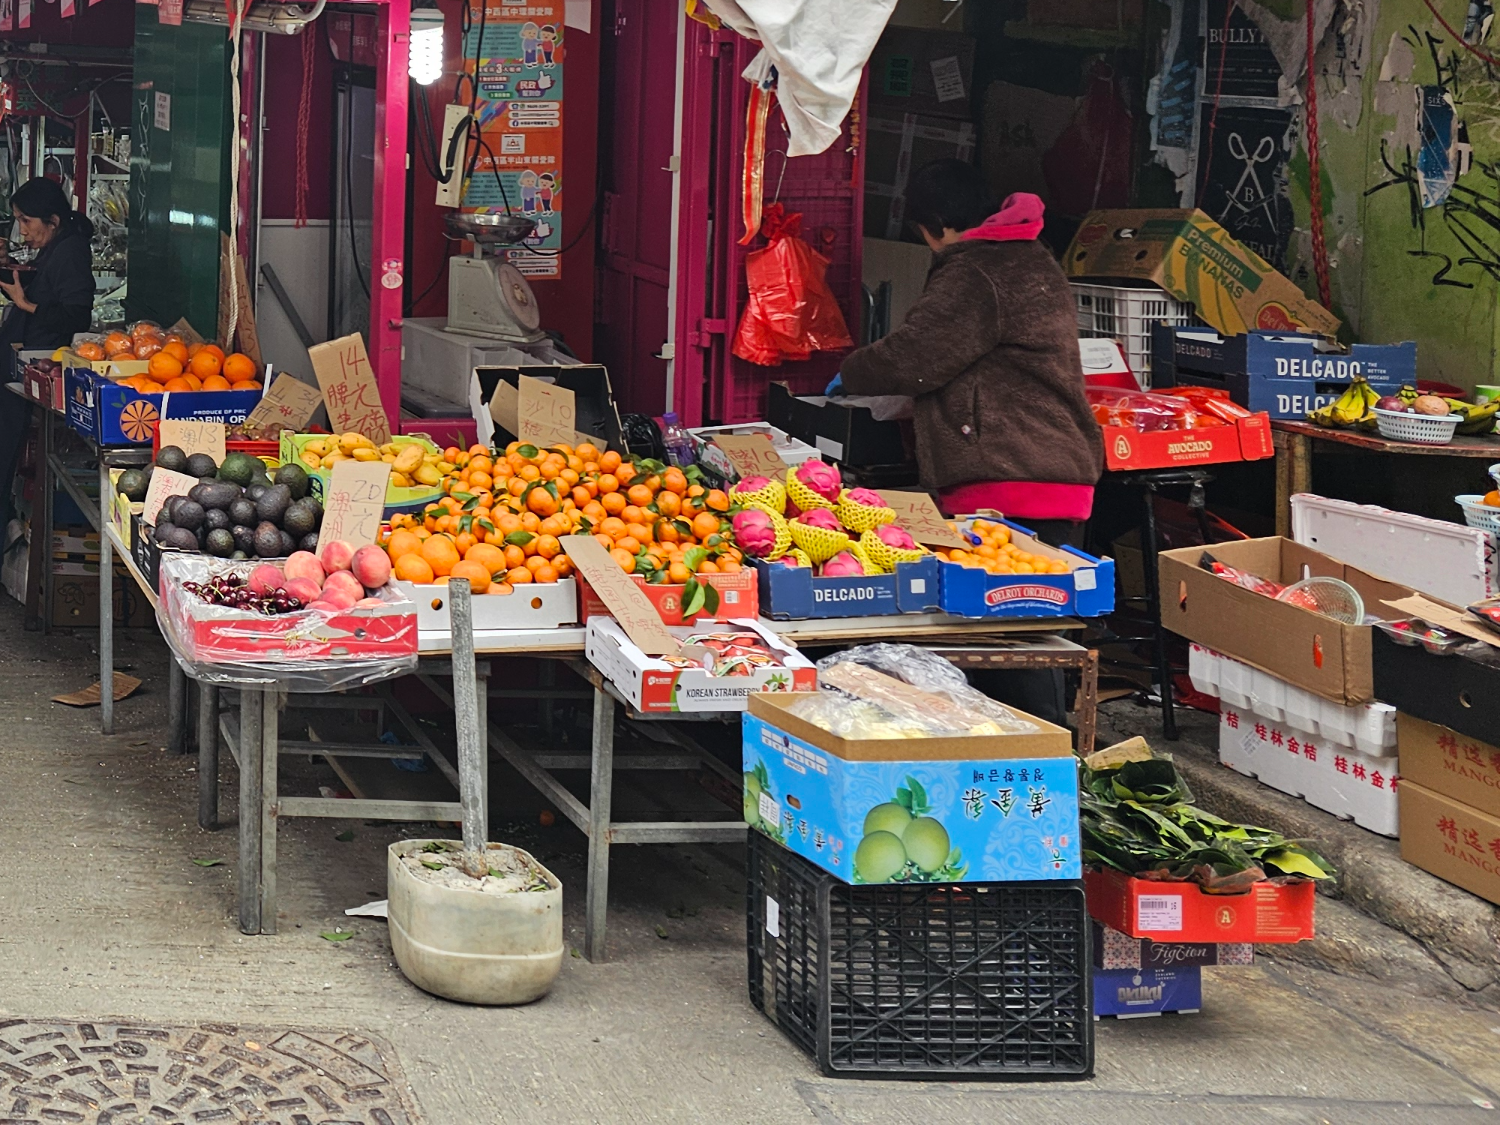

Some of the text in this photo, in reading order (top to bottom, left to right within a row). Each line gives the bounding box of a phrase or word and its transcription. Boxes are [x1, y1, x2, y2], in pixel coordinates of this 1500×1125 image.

[1243, 187, 1255, 203] B
[1186, 229, 1245, 278] Premium
[1178, 244, 1245, 301] BANANAS
[1174, 342, 1213, 359] DELCADO
[340, 345, 366, 381] 14
[1275, 357, 1361, 379] DELCADO
[1276, 394, 1335, 415] DELCA
[1167, 439, 1213, 454] AVOCADO
[1172, 452, 1210, 461] COLLECTIVE
[351, 480, 381, 503] 20
[665, 596, 677, 610] A
[813, 587, 875, 602] DELCADO
[991, 586, 1067, 603] DELROY ORCHARDS
[686, 687, 761, 698] KOREAN STRAWBERRY
[1255, 721, 1318, 763] 桂林金桔
[972, 767, 1046, 783] 정통황금배
[1221, 910, 1231, 924] A
